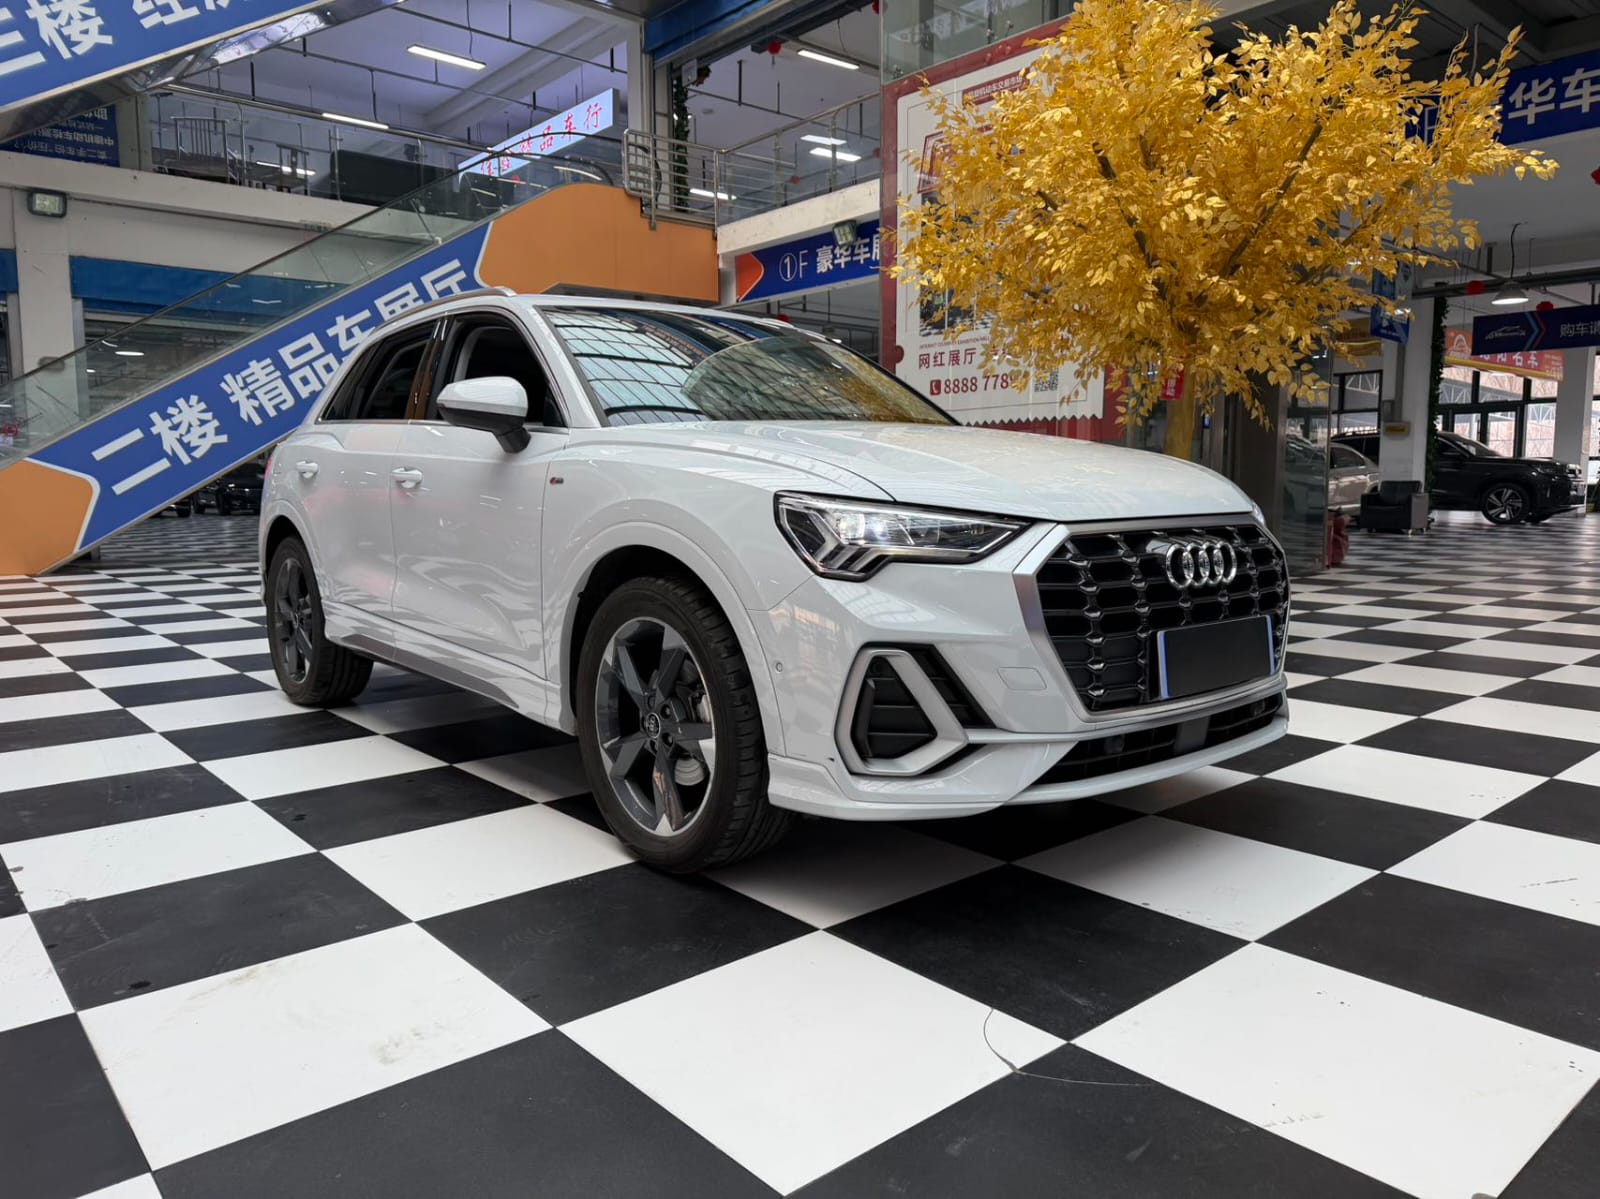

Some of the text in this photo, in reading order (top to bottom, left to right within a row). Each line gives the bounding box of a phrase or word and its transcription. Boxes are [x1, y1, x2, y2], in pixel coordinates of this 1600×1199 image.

[1496, 68, 1600, 125] 华车
[91, 258, 467, 495] 二楼 精品车展厅
[918, 347, 977, 369] 网红展厅
[944, 373, 1013, 394] 8888 778
